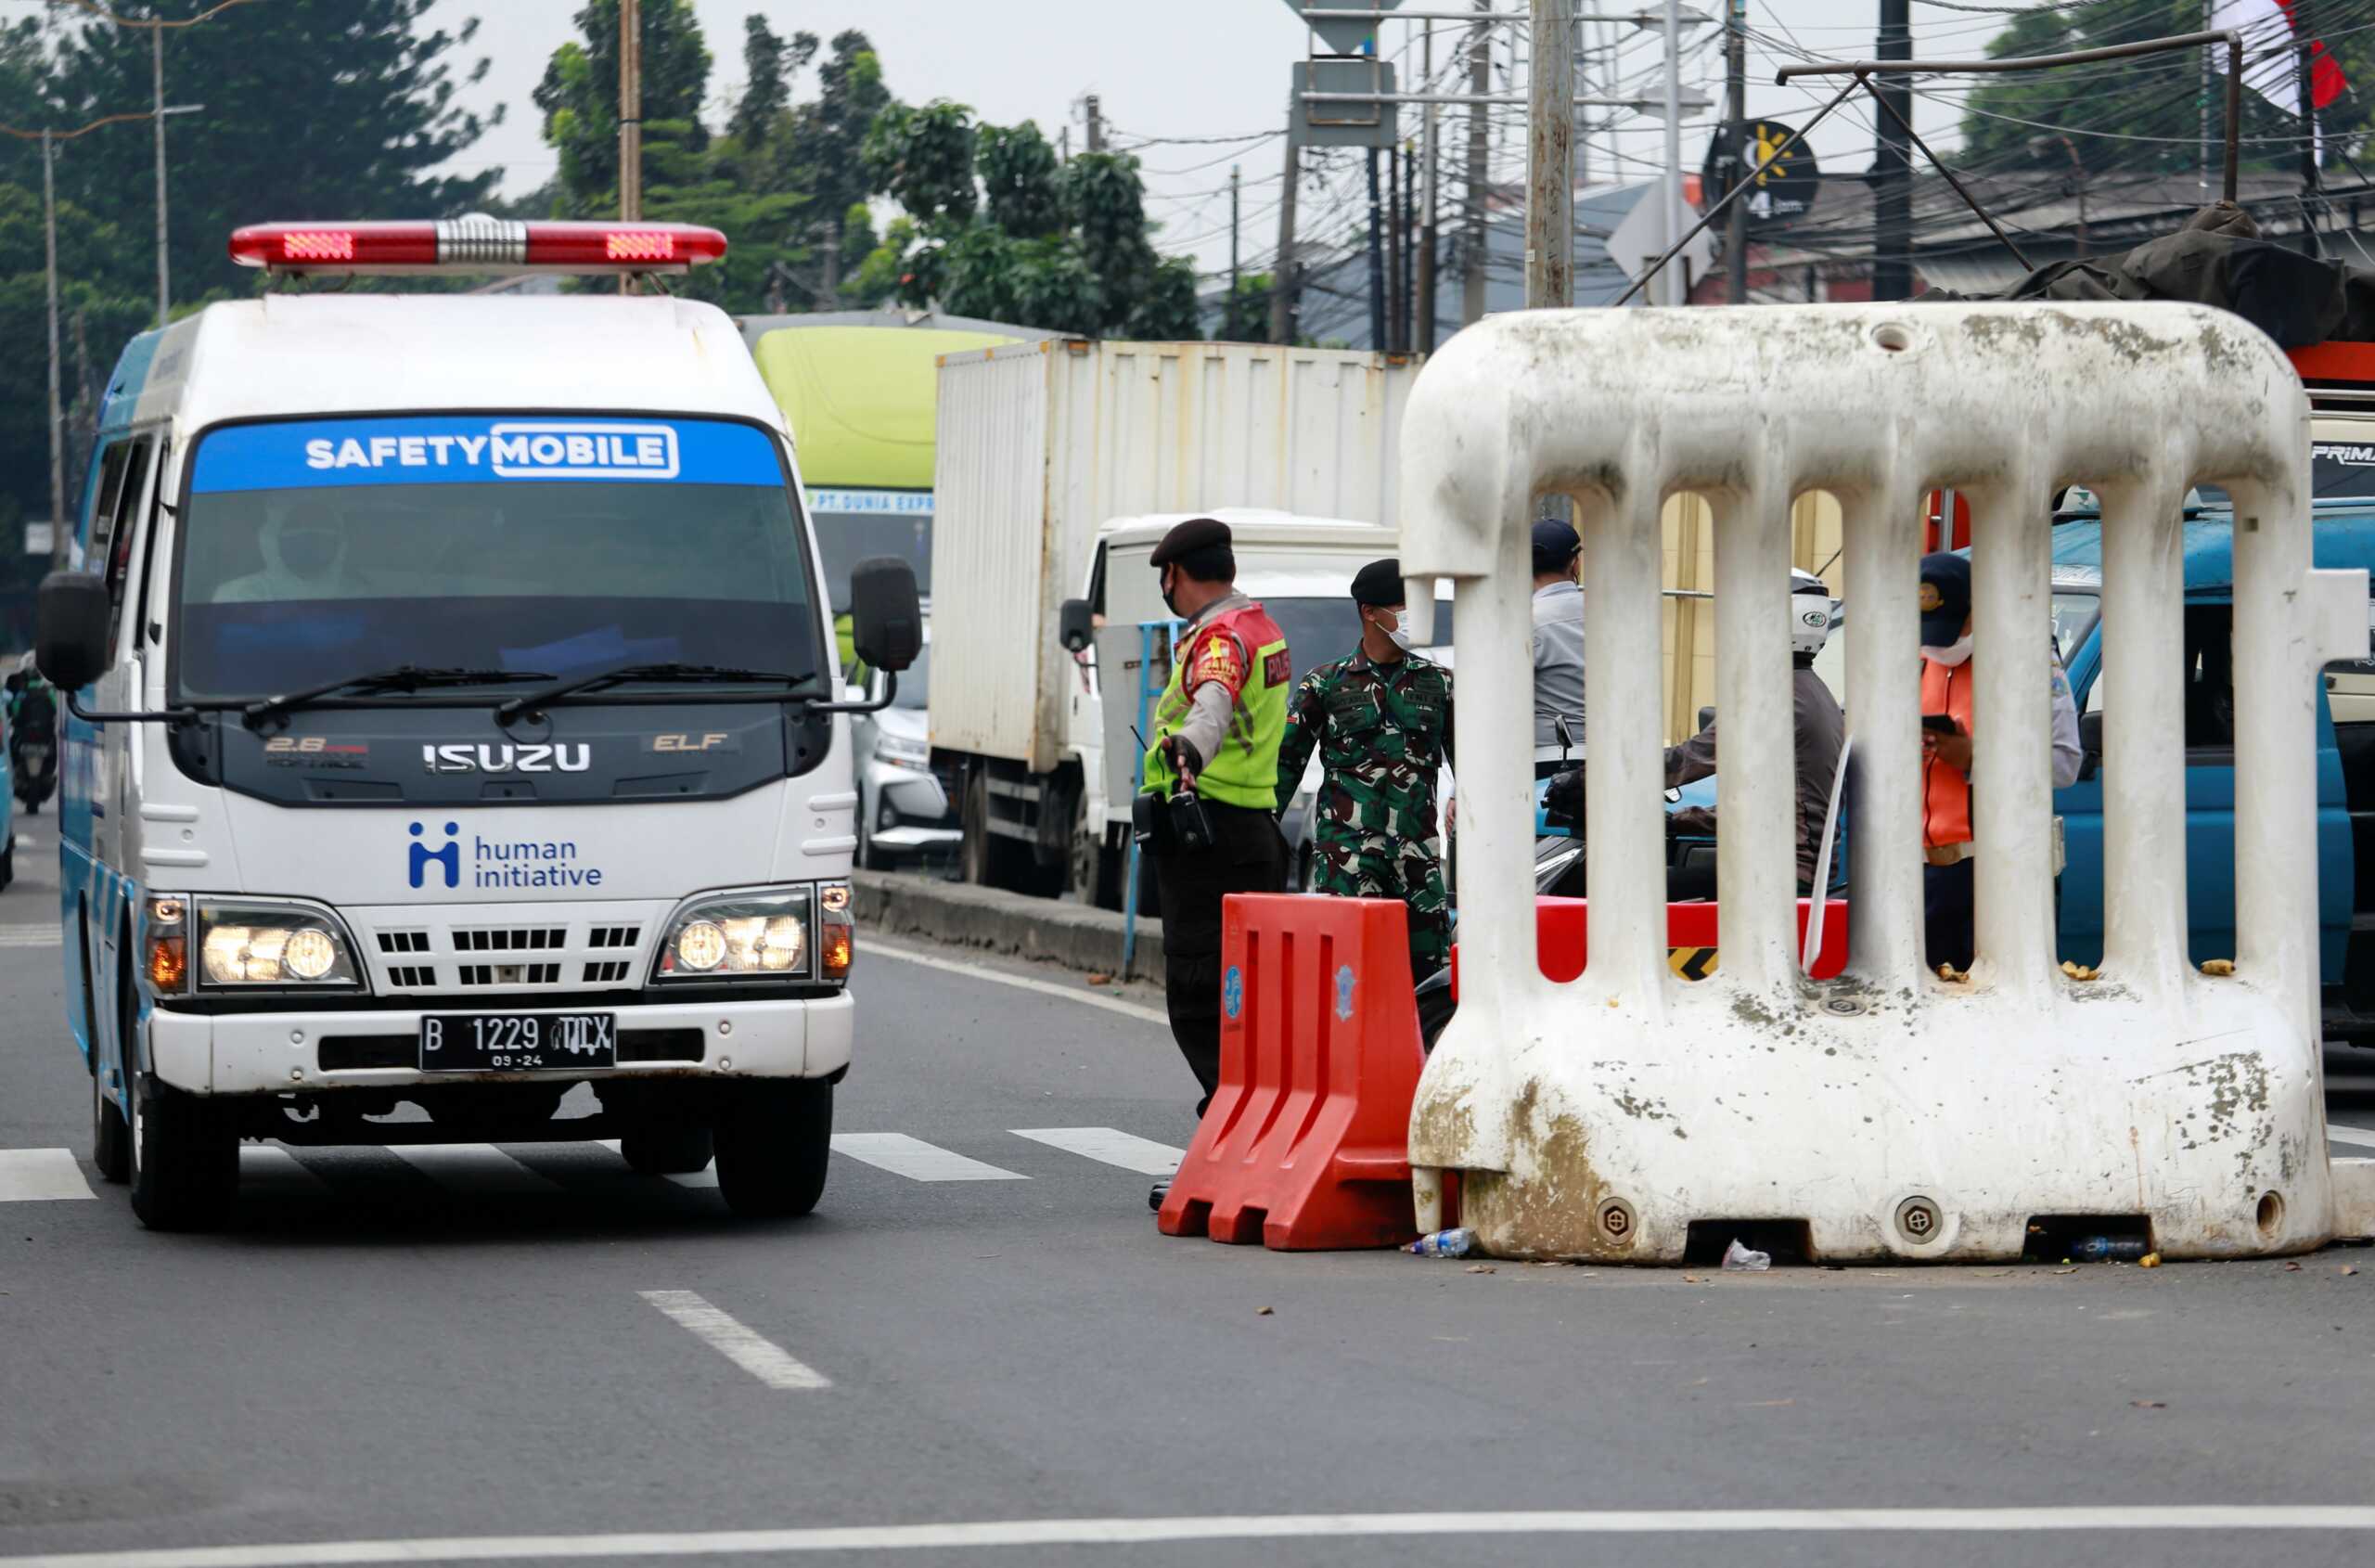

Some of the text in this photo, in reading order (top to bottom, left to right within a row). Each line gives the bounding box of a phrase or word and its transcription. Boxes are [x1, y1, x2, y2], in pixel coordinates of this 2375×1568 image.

[842, 494, 890, 511] DUNIA
[653, 733, 727, 752] ELF
[422, 743, 590, 773] ISUZU
[476, 836, 576, 860] human
[476, 863, 602, 888] initiative
[425, 1019, 443, 1051] B
[473, 1018, 539, 1050] 1229
